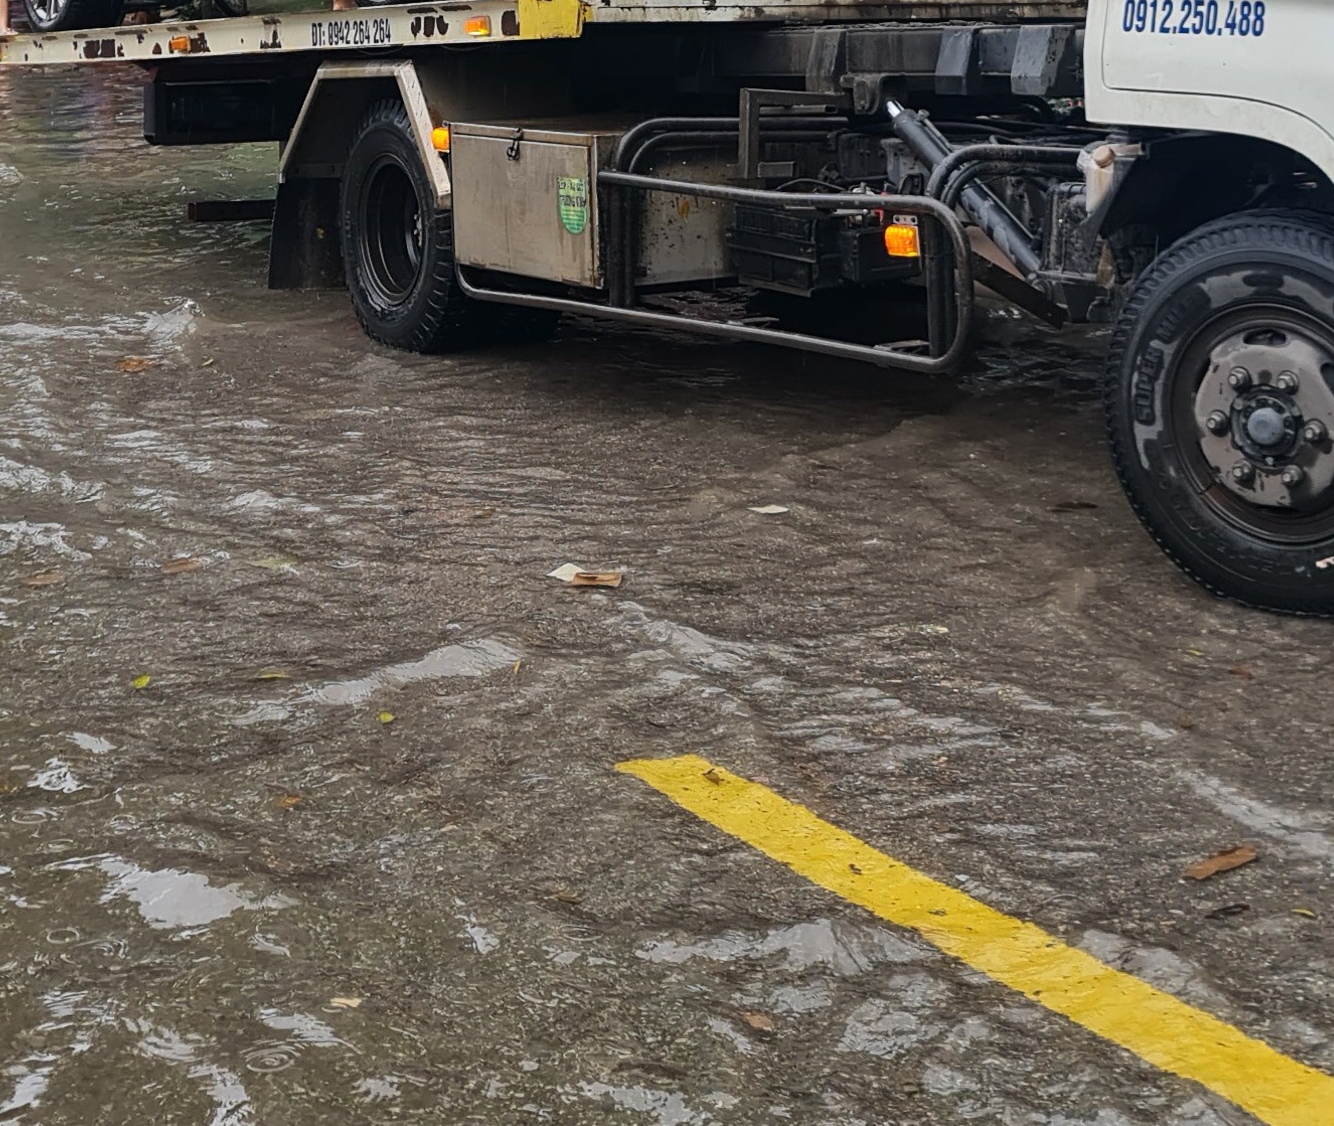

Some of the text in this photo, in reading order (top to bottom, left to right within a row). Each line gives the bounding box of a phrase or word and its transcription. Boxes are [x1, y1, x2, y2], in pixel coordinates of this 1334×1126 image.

[328, 20, 351, 46] 0942
[352, 20, 371, 45] 264
[373, 18, 391, 43] 264
[1135, 347, 1164, 425] SUPER
